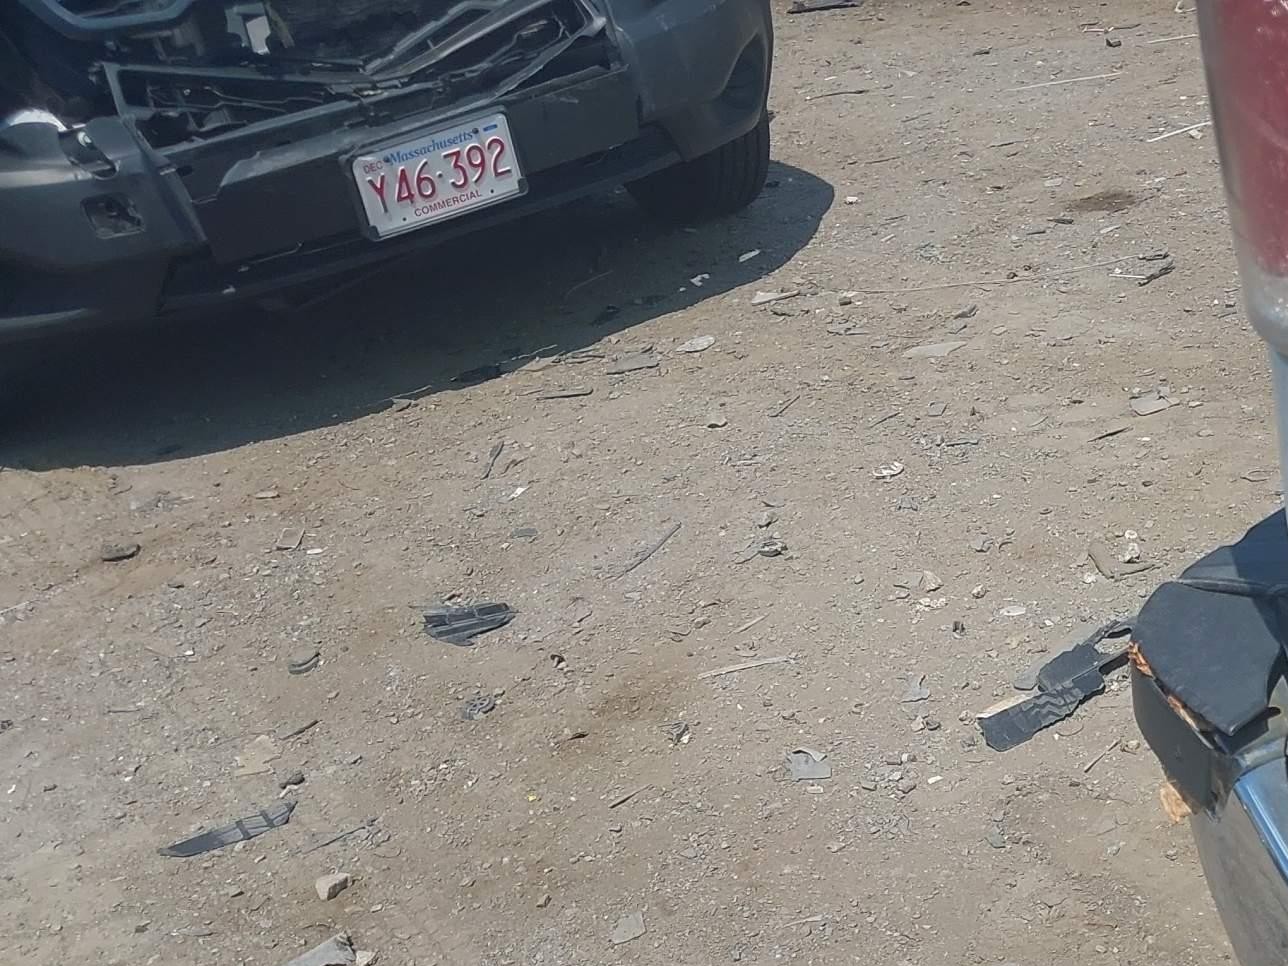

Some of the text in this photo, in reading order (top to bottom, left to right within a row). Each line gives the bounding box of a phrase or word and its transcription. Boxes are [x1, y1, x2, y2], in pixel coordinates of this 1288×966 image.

[389, 131, 474, 166] Massachusetts
[363, 160, 384, 174] DEC
[414, 189, 483, 217] COMMERCIAL
